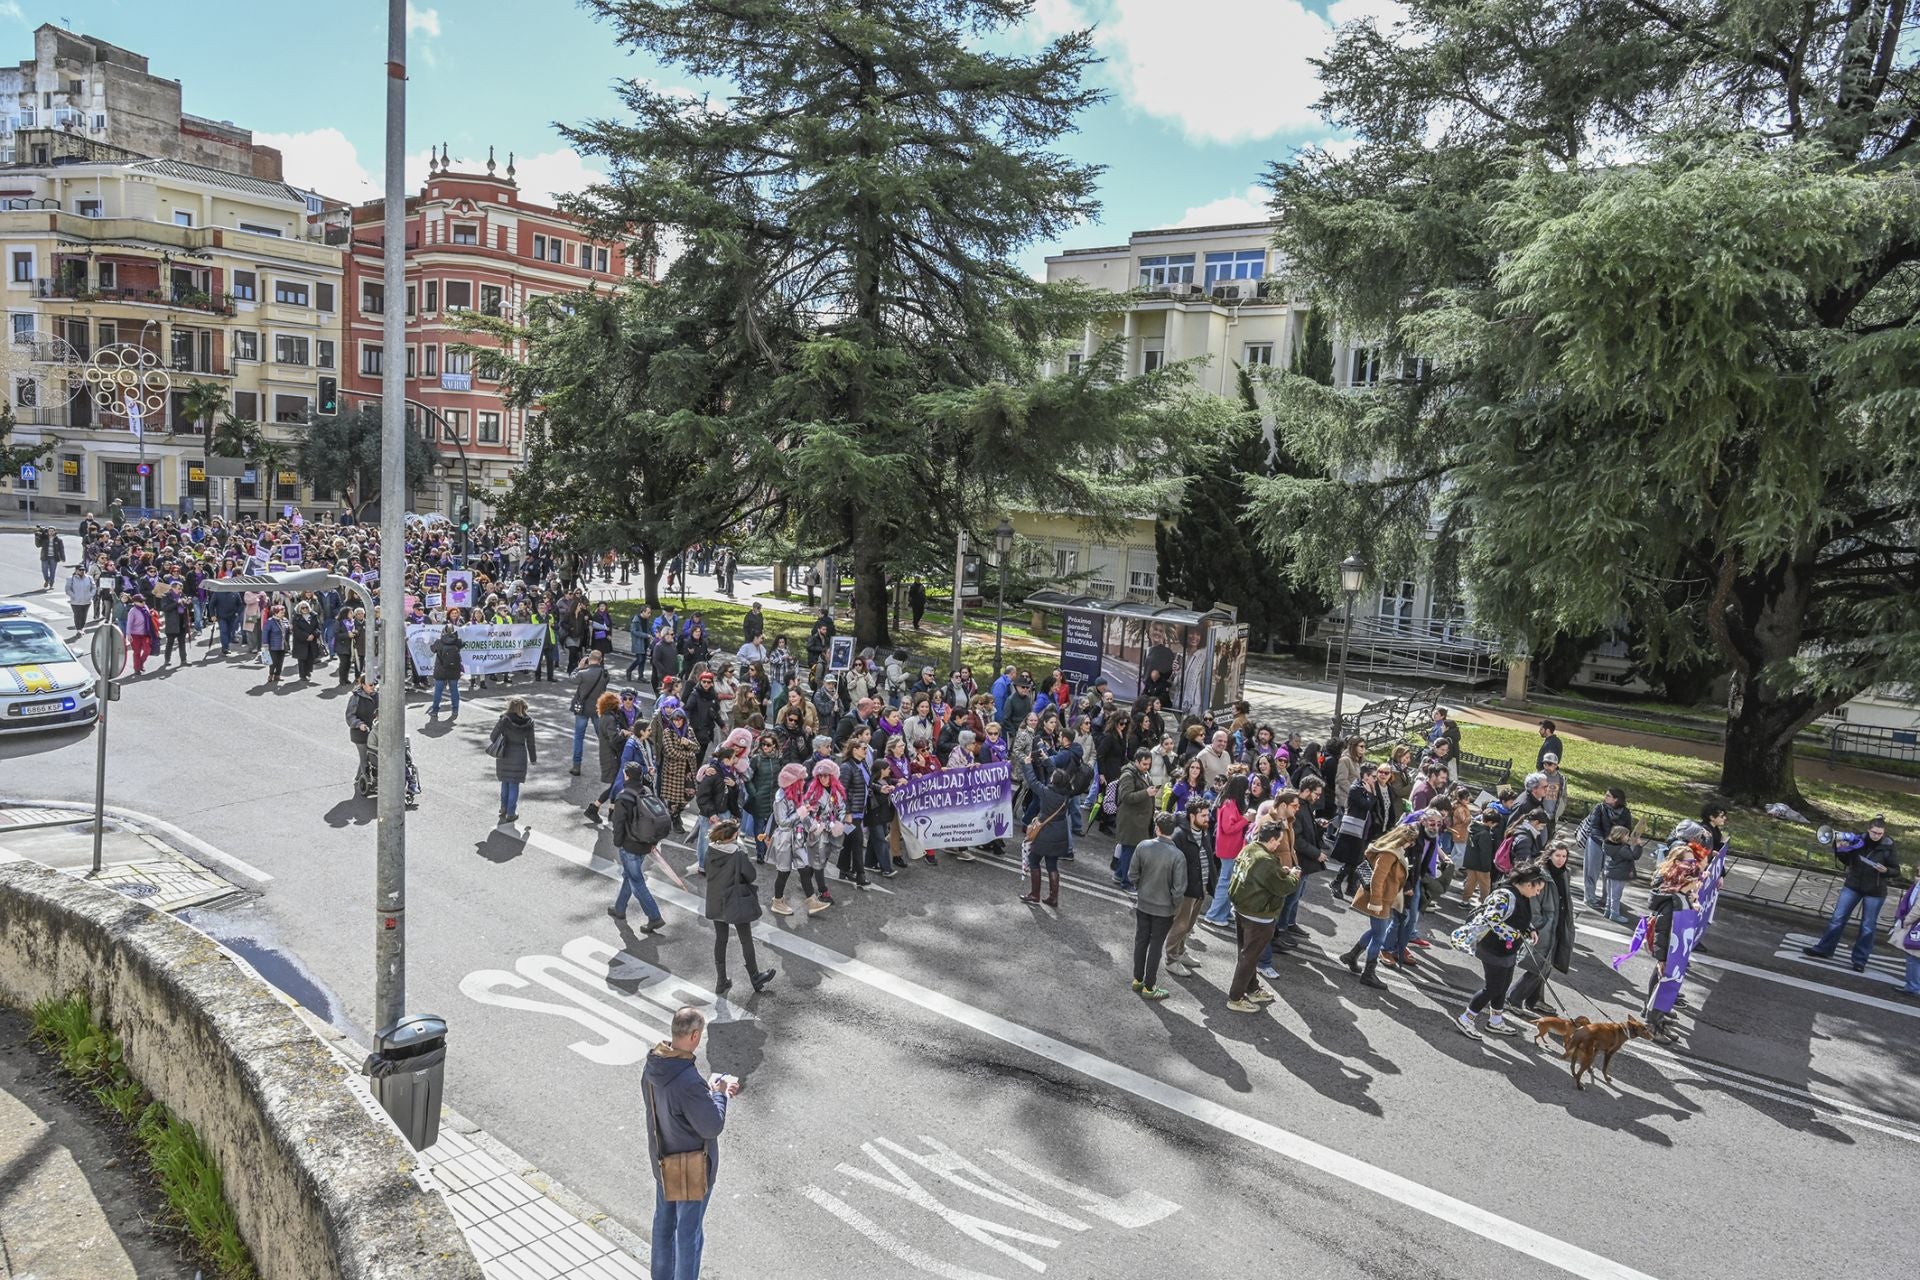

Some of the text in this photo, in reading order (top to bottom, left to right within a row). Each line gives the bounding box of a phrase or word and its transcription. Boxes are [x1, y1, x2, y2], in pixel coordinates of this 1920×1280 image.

[1075, 631, 1092, 639] tienda
[517, 639, 522, 648] Y
[1066, 637, 1098, 648] RENOVADA
[906, 784, 917, 799] LA
[918, 772, 965, 795] IGUALDAD
[968, 771, 974, 786] Y
[974, 766, 1009, 784] CONTRA
[907, 792, 952, 814] VIOLENCIA
[956, 790, 969, 806] DE
[931, 828, 984, 838] Mujeres Progresistas
